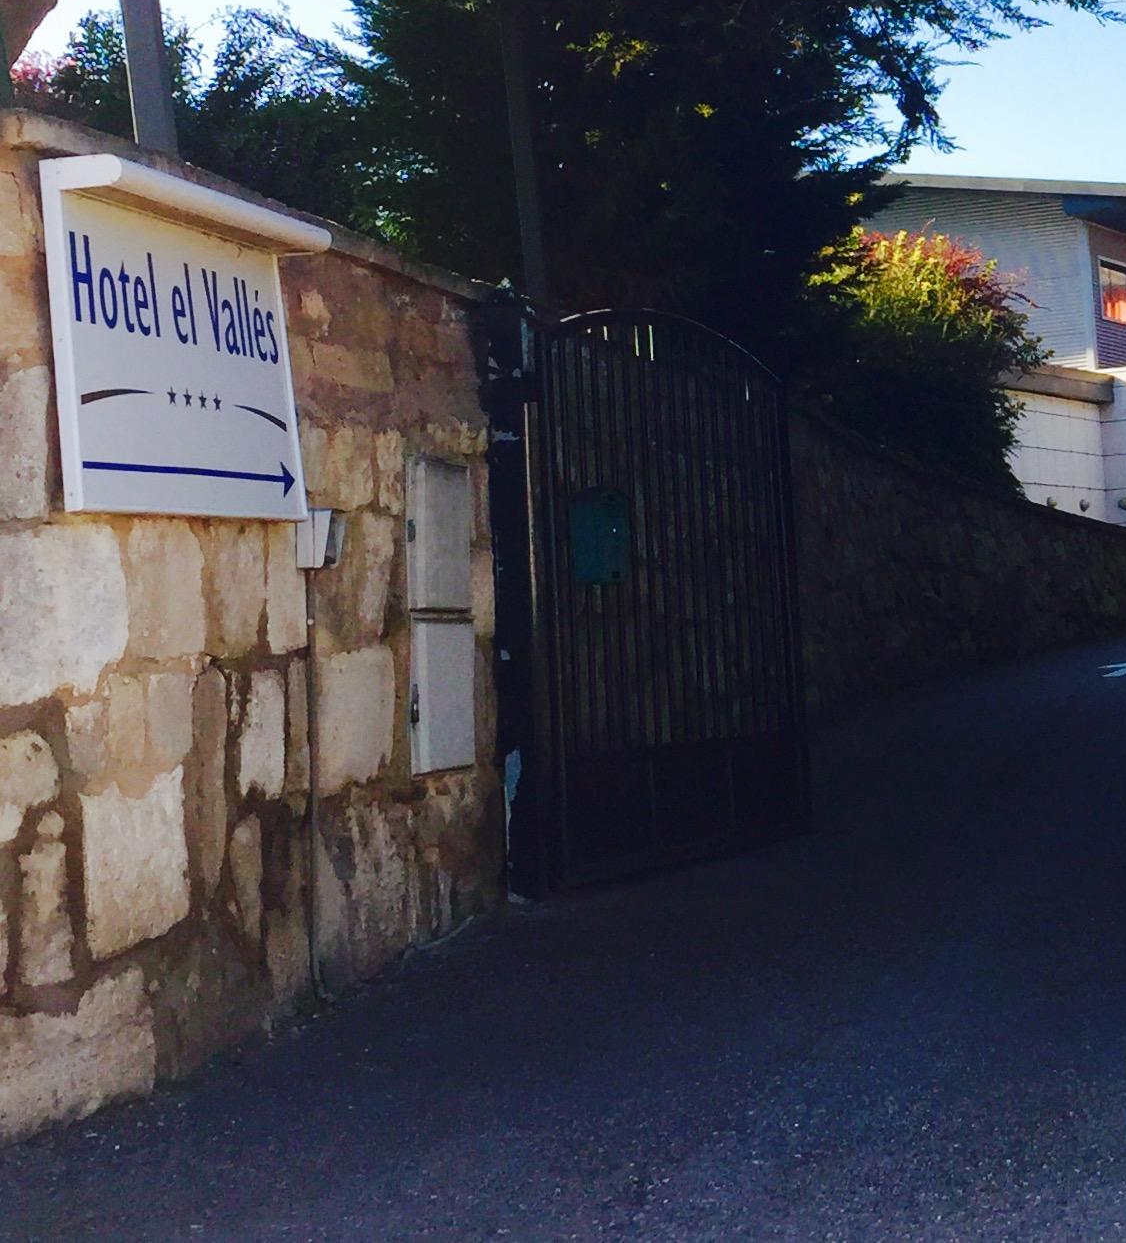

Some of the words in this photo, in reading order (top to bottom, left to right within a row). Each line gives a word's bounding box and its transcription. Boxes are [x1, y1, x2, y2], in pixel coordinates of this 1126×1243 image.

[69, 232, 160, 337] Hotel
[172, 263, 198, 345] el
[201, 269, 279, 364] Vallés
